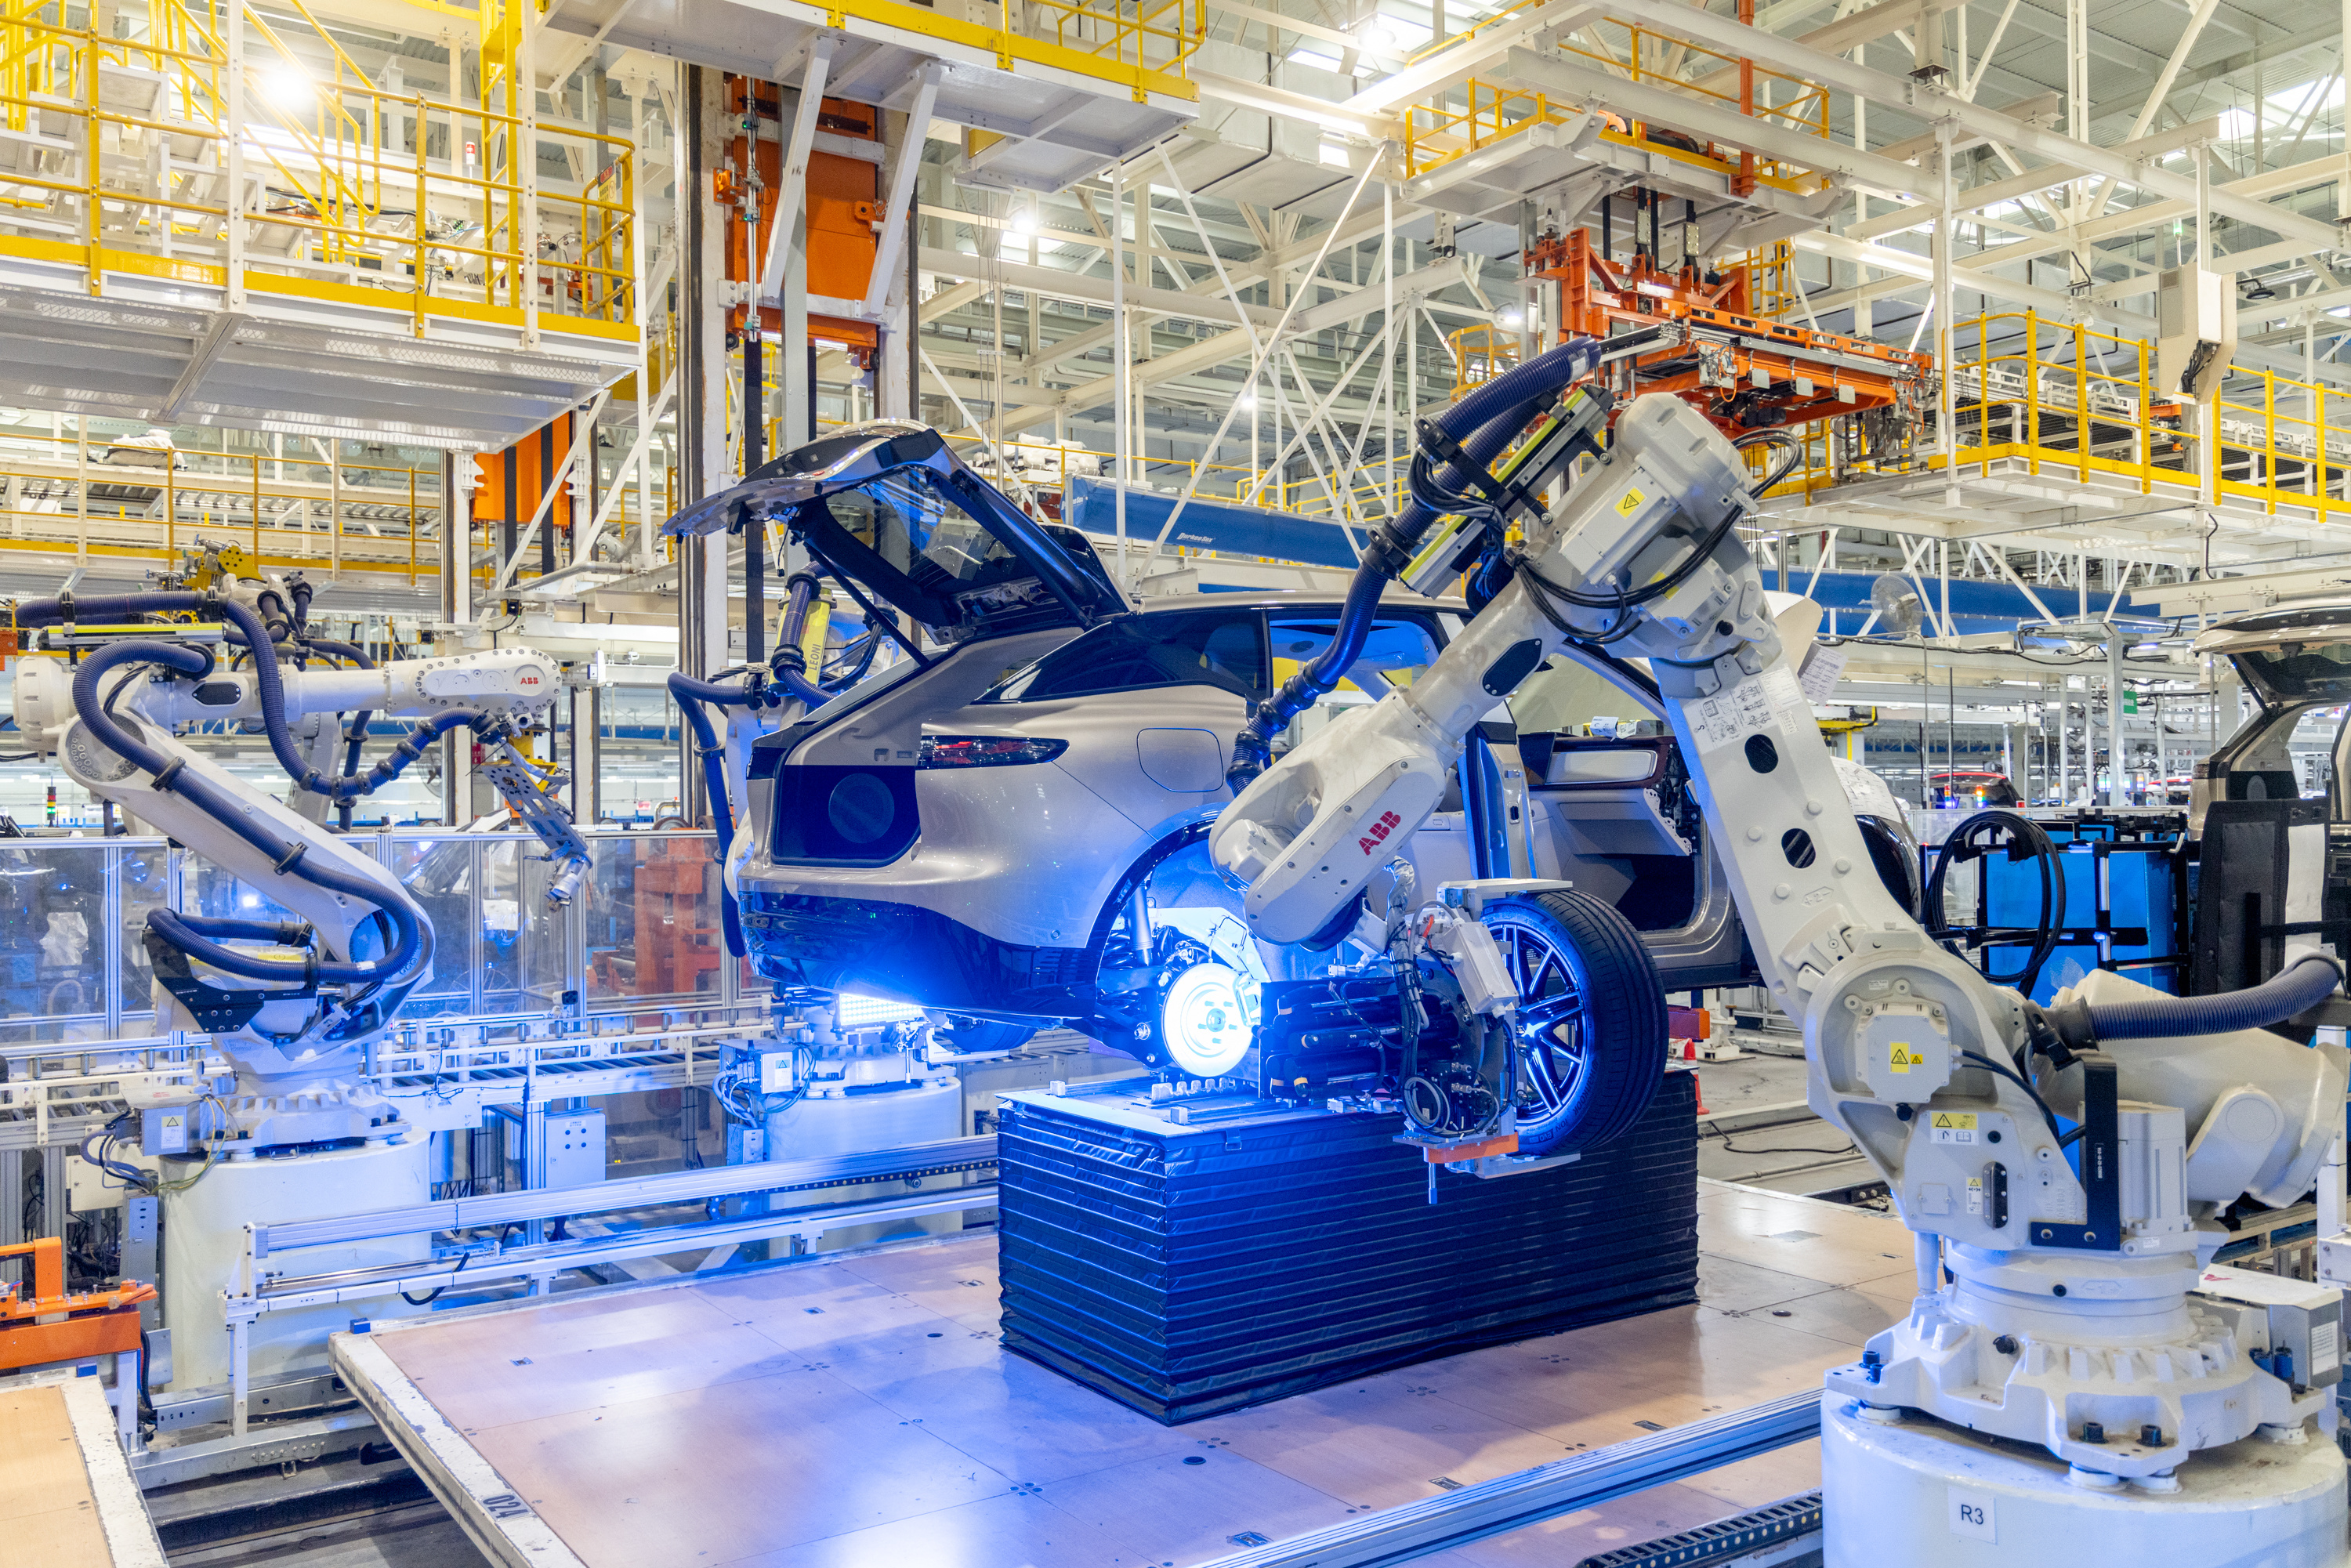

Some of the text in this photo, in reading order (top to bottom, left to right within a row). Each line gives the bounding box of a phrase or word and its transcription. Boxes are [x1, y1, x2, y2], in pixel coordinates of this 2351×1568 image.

[808, 643, 822, 671] LEONI
[1358, 810, 1401, 856] ABB
[483, 1495, 529, 1519] 024
[1961, 1504, 1984, 1525] R3
